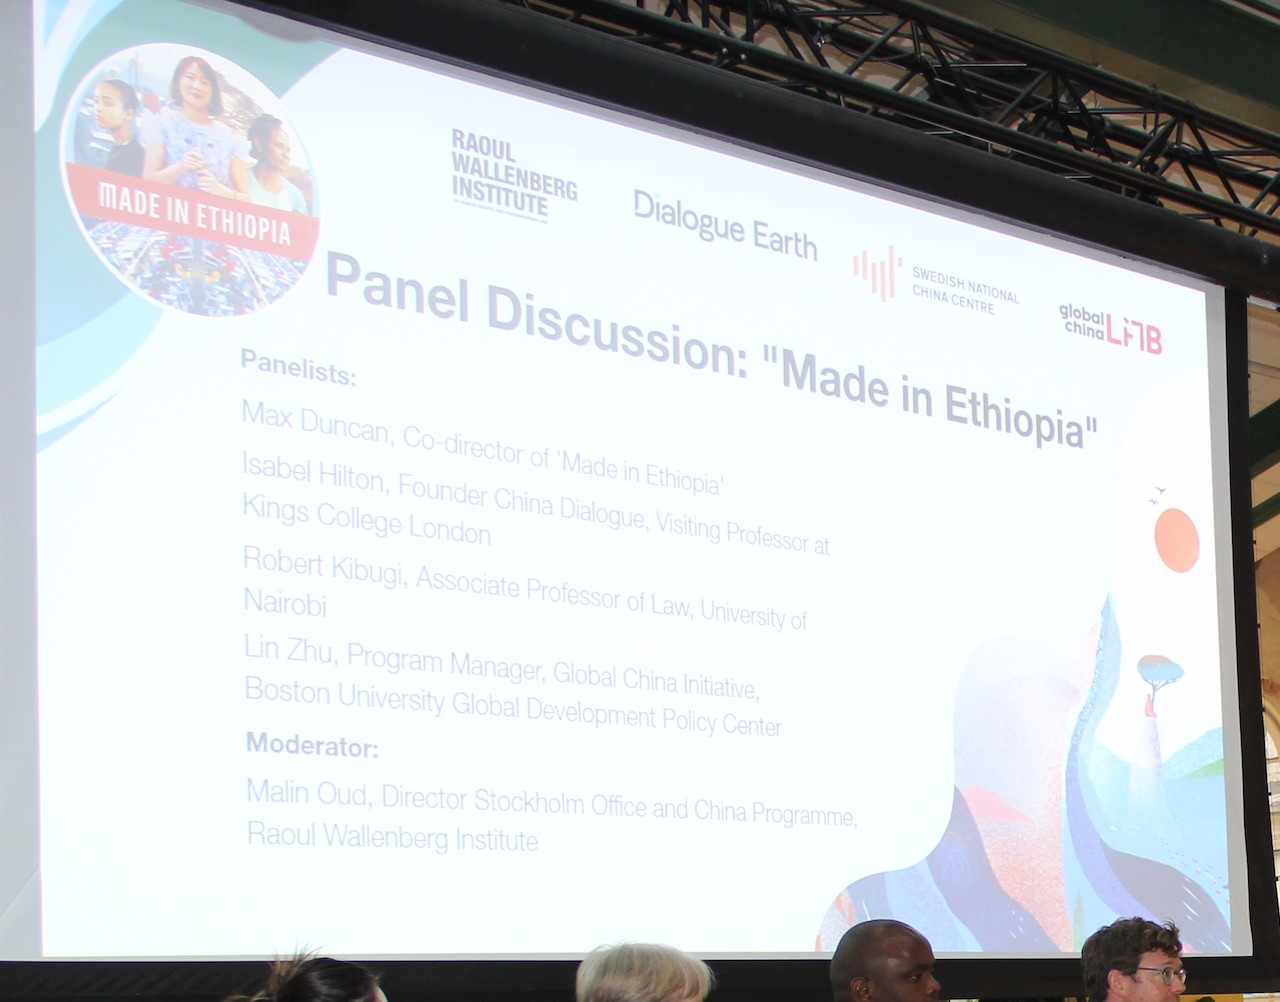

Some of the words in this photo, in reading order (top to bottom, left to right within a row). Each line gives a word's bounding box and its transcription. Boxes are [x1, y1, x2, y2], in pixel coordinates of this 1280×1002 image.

[452, 128, 516, 163] RAOUL
[452, 151, 578, 201] WALLENBERG
[453, 175, 548, 216] INSTITUTE
[98, 182, 160, 219] MADE
[167, 197, 190, 225] IN
[197, 203, 292, 246] ETHIOPIA
[634, 188, 745, 243] Dialogue
[753, 220, 818, 262] Earth
[913, 266, 965, 290] SWEDISH
[968, 280, 1020, 304] NATIONAL
[913, 284, 949, 304] CHINA
[951, 294, 995, 315] CENTRE
[1059, 303, 1104, 326] global
[1065, 320, 1105, 341] china
[241, 348, 356, 387] Panelists:
[328, 251, 468, 322] Panel
[489, 285, 746, 378] Discussion:
[764, 344, 889, 407] "Made
[902, 375, 932, 417] in
[946, 384, 1097, 449] Ethiopia"
[242, 399, 293, 429] Max
[301, 408, 394, 448] Duncan,
[403, 425, 524, 464] Co-director
[530, 448, 550, 468] of
[557, 449, 618, 479] 'Made
[624, 460, 639, 483] in
[646, 464, 723, 497] Ethiopia'
[243, 451, 310, 482] Isabel
[320, 461, 389, 496] Hilton,
[399, 473, 488, 506] Founder
[495, 488, 554, 516] China
[561, 496, 649, 532] Dialogue,
[656, 511, 720, 544] Visiting
[727, 521, 809, 552] Professor
[814, 537, 830, 556] at
[243, 492, 309, 526] Kings
[317, 503, 402, 538] College
[410, 514, 491, 546] London
[244, 545, 324, 576] Robert
[332, 555, 408, 590] Kibugi,
[416, 565, 519, 598] Associate
[527, 578, 621, 608] Professor
[627, 592, 645, 612] of
[652, 593, 693, 621] Law,
[701, 599, 785, 633] University
[791, 611, 807, 630] of
[244, 587, 326, 617] Nairobi
[245, 633, 279, 659] Lin
[287, 637, 338, 668] Zhu,
[348, 642, 443, 674] Program
[451, 652, 545, 685] Manager,
[553, 661, 616, 687] Global
[623, 668, 678, 693] China
[684, 673, 759, 703] Initiative,
[245, 675, 330, 704] Boston
[339, 683, 445, 718] University
[452, 692, 519, 718] Global
[527, 697, 656, 729] Development
[663, 708, 717, 737] Policy
[723, 713, 782, 737] Center
[246, 731, 378, 758] Moderator:
[247, 778, 309, 803] Malin
[317, 781, 372, 809] Oud,
[383, 784, 468, 810] Director
[475, 788, 584, 814] Stockholm
[591, 794, 647, 817] Office
[653, 799, 688, 819] and
[695, 799, 747, 821] China
[753, 802, 857, 829] Programme,
[248, 820, 315, 846] Raoul
[323, 823, 448, 855] Wallenberg
[457, 827, 538, 851] Institute
